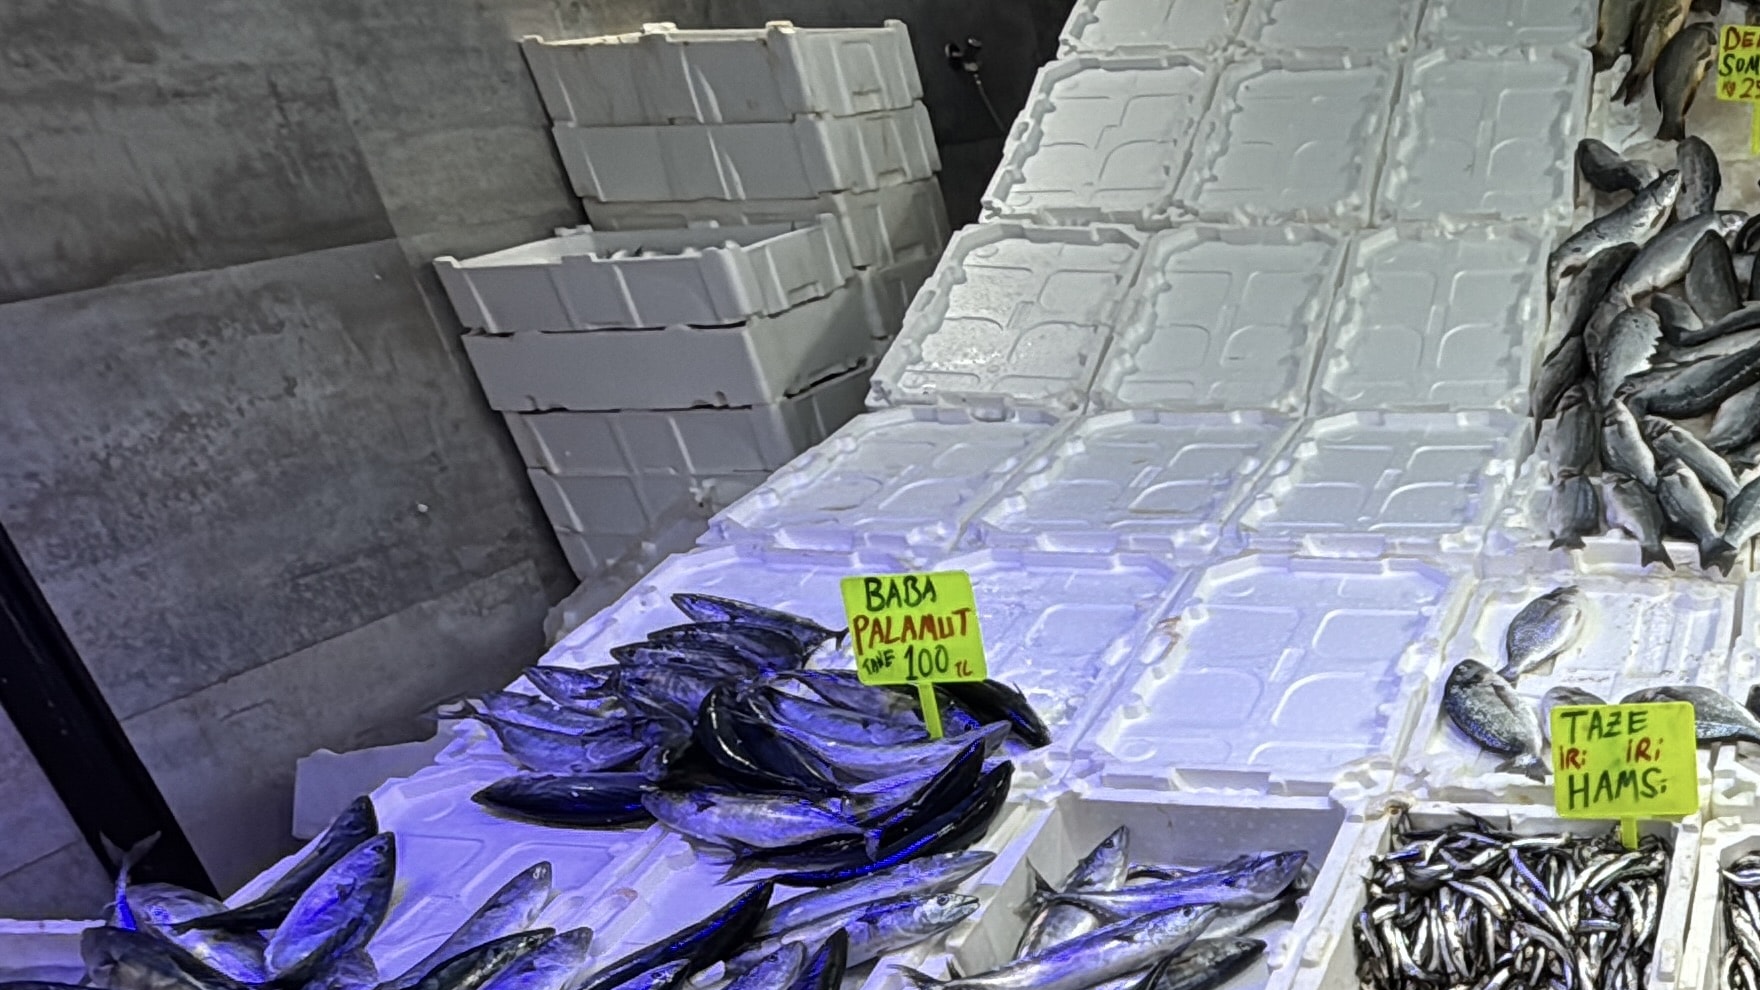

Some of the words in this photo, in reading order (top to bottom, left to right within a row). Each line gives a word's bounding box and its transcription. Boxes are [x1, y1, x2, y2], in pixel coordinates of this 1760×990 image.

[864, 575, 937, 612] BABA
[853, 607, 972, 656] PALAMUT
[904, 645, 950, 681] 100
[1560, 709, 1649, 744] TAZE
